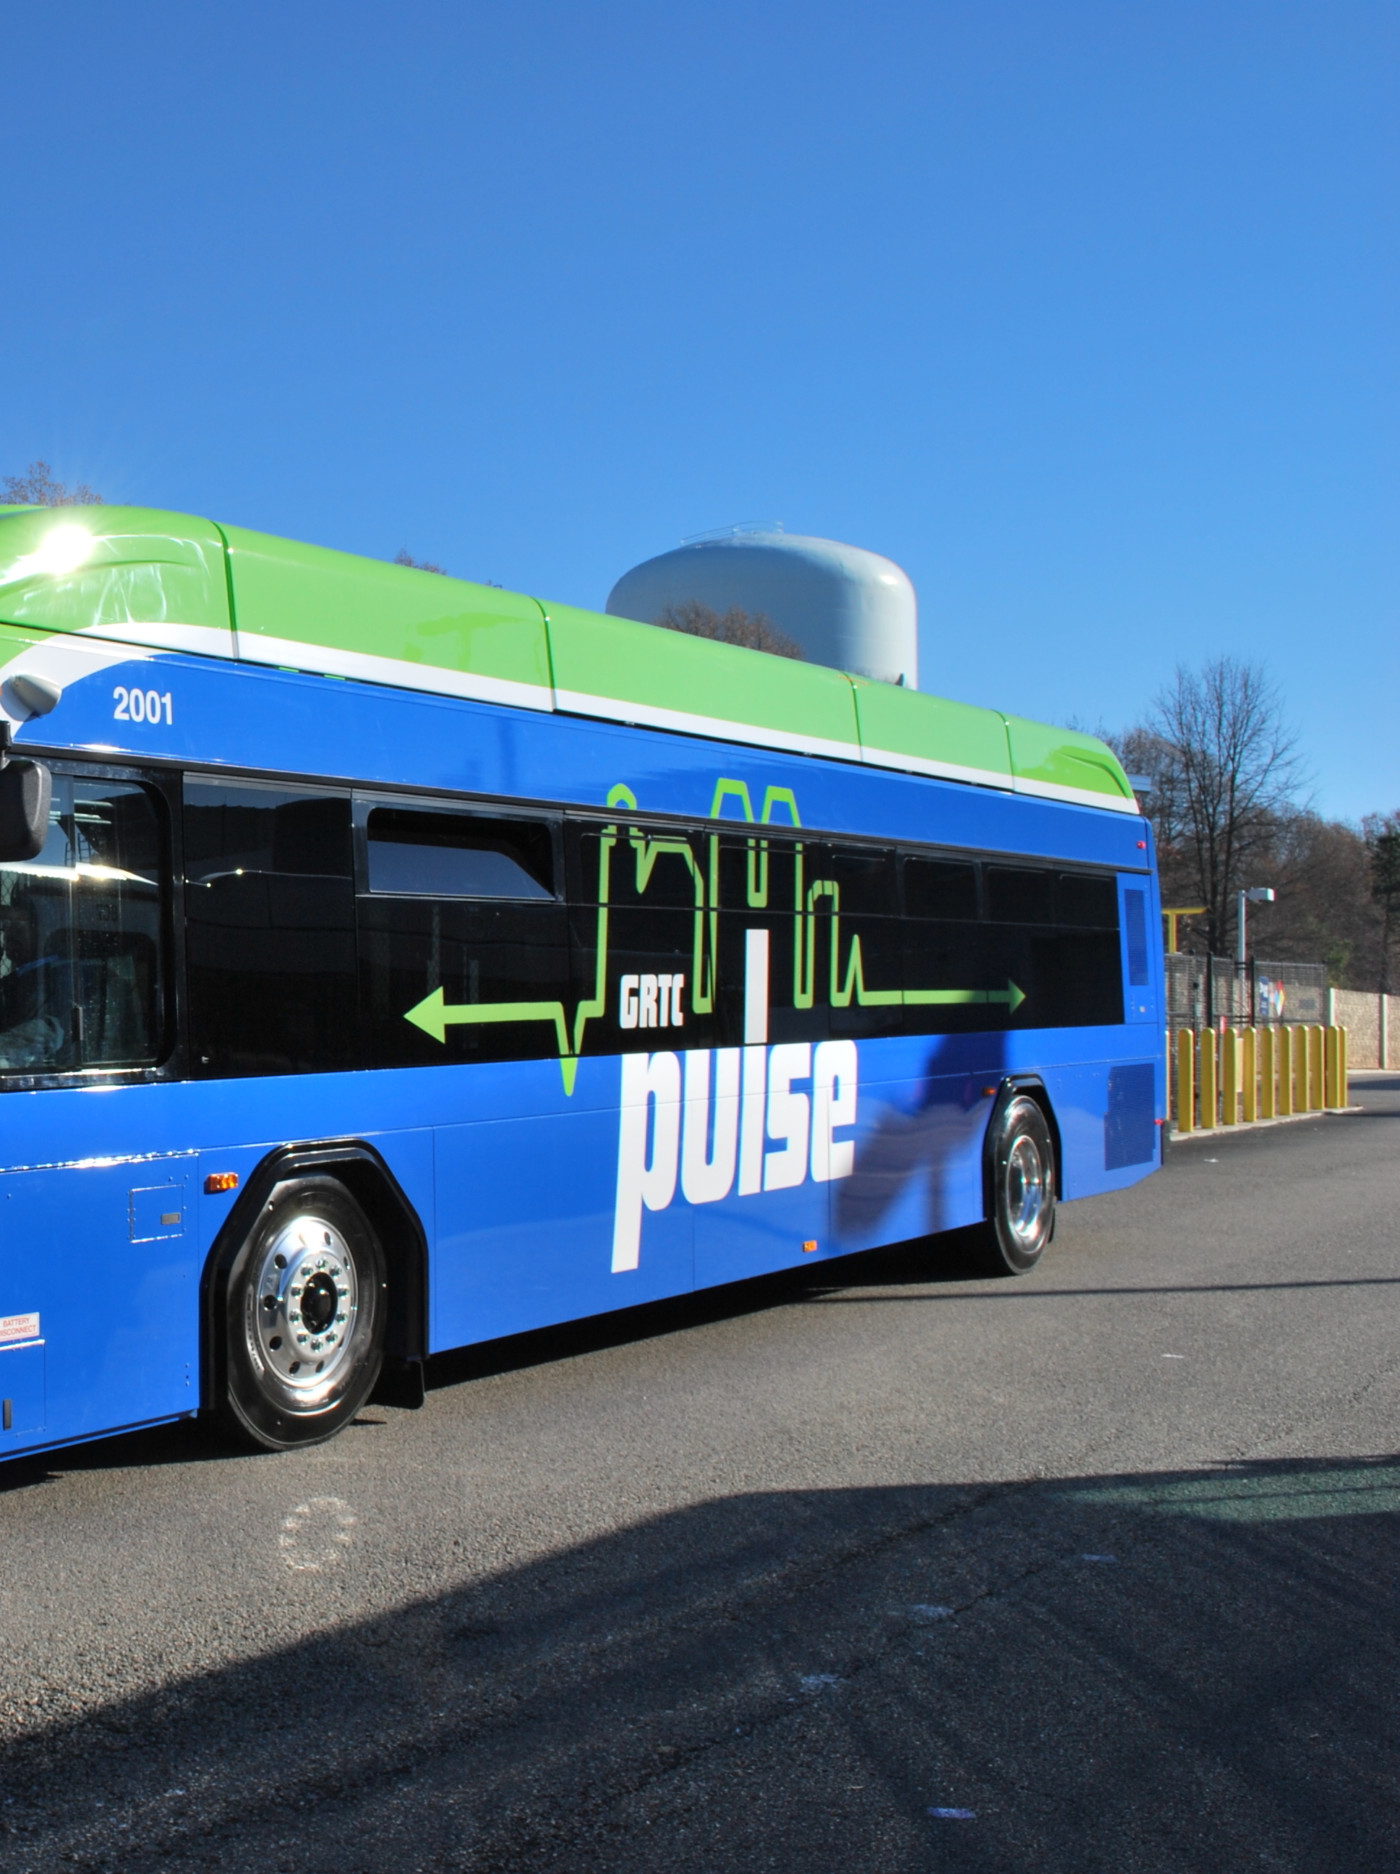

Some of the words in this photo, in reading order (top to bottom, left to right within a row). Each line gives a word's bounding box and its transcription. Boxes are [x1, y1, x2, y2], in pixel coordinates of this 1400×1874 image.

[112, 685, 173, 726] 2001
[619, 973, 685, 1030] GRTC
[610, 929, 858, 1274] pulse
[2, 1317, 30, 1328] BATTERY
